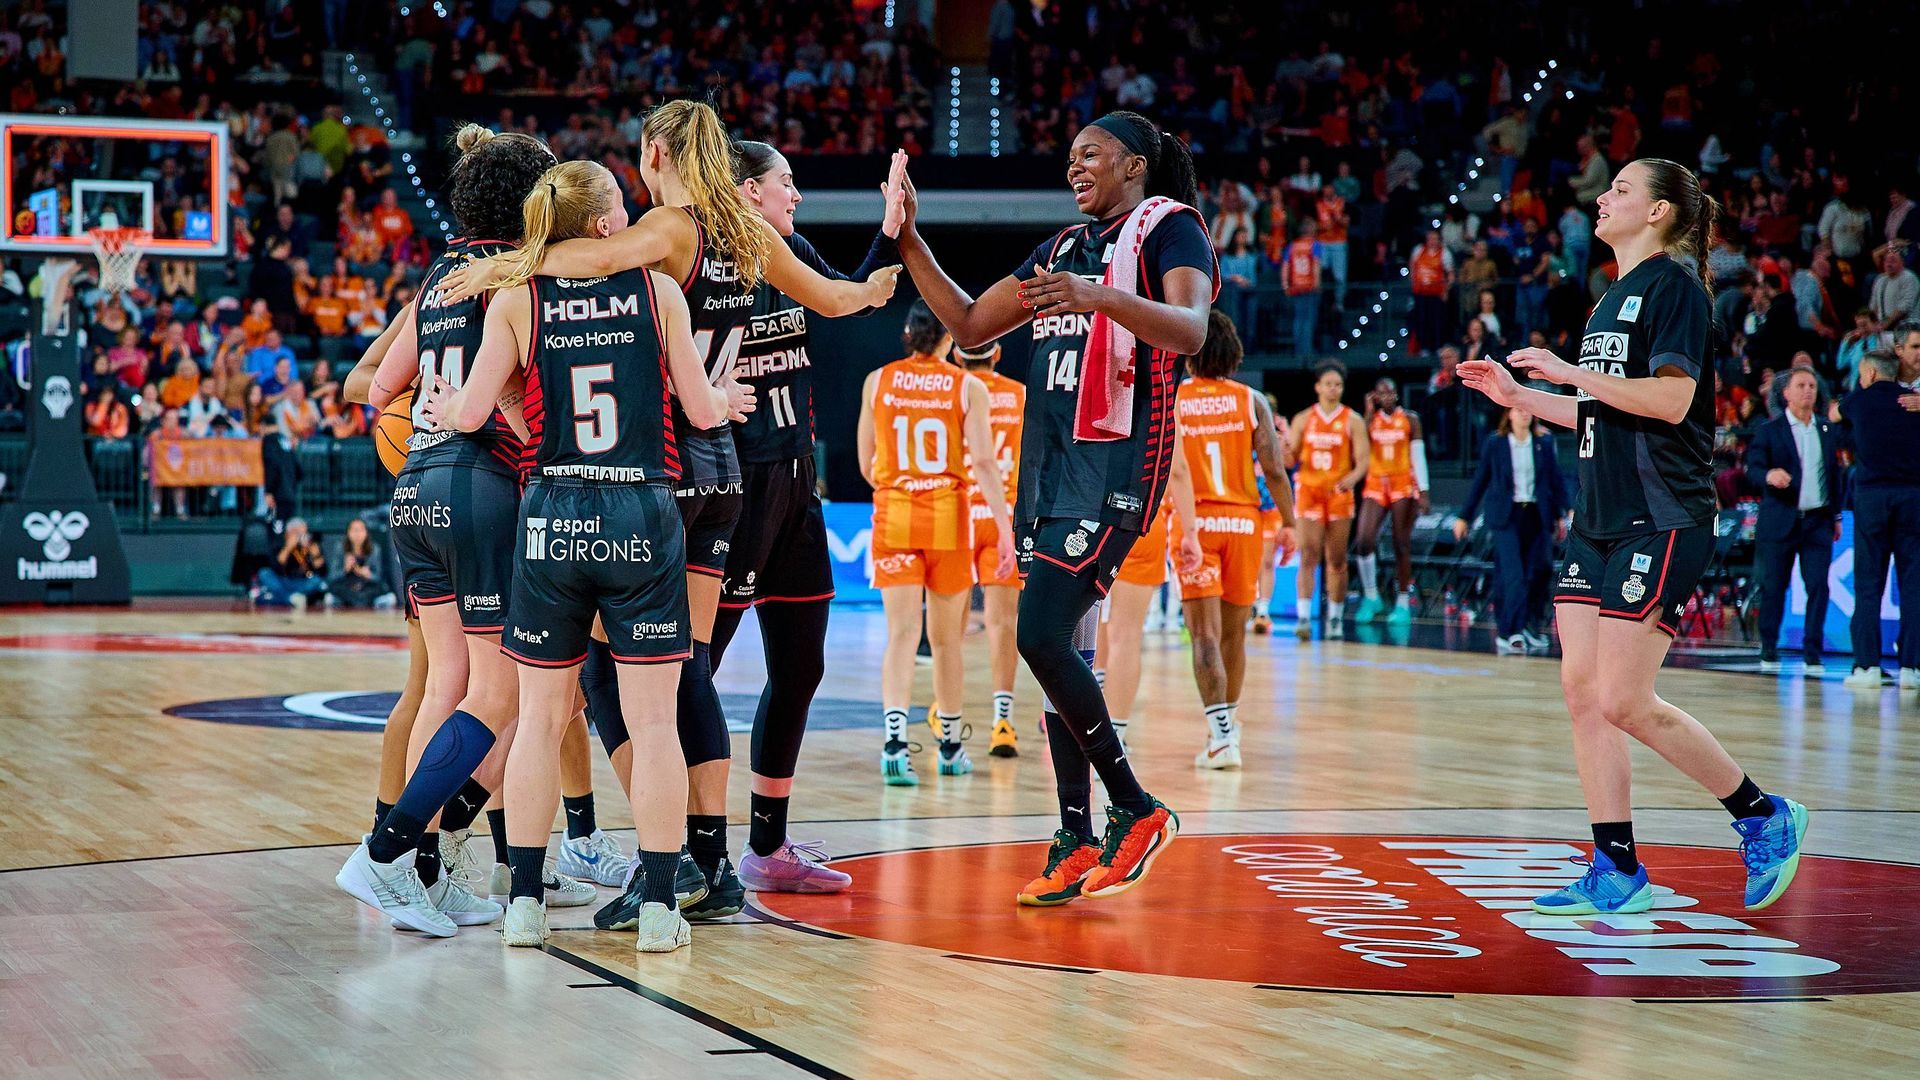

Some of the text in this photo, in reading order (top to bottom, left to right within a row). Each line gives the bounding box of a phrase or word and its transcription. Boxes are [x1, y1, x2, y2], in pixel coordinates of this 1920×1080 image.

[543, 294, 639, 323] HOLM
[1033, 314, 1093, 340] GIRON
[545, 331, 635, 350] Kave Home
[1580, 337, 1603, 356] PAR
[892, 370, 954, 392] ROMERO
[1046, 350, 1078, 392] 14
[571, 363, 619, 456] 5
[768, 385, 797, 428] 11
[1180, 394, 1238, 417] ANDERSON
[893, 415, 949, 474] 10
[1579, 417, 1595, 458] 25
[1206, 441, 1226, 496] 1
[393, 483, 420, 503] espai
[905, 478, 952, 492] Midea
[391, 501, 452, 528] GIRONÈS
[552, 516, 600, 536] espai
[1197, 516, 1255, 535] PAMESA
[550, 534, 652, 562] GIRONÈS
[17, 556, 98, 580] hummel
[464, 593, 501, 611] ginvest
[513, 626, 543, 645] Marlex
[632, 620, 678, 640] ginvest
